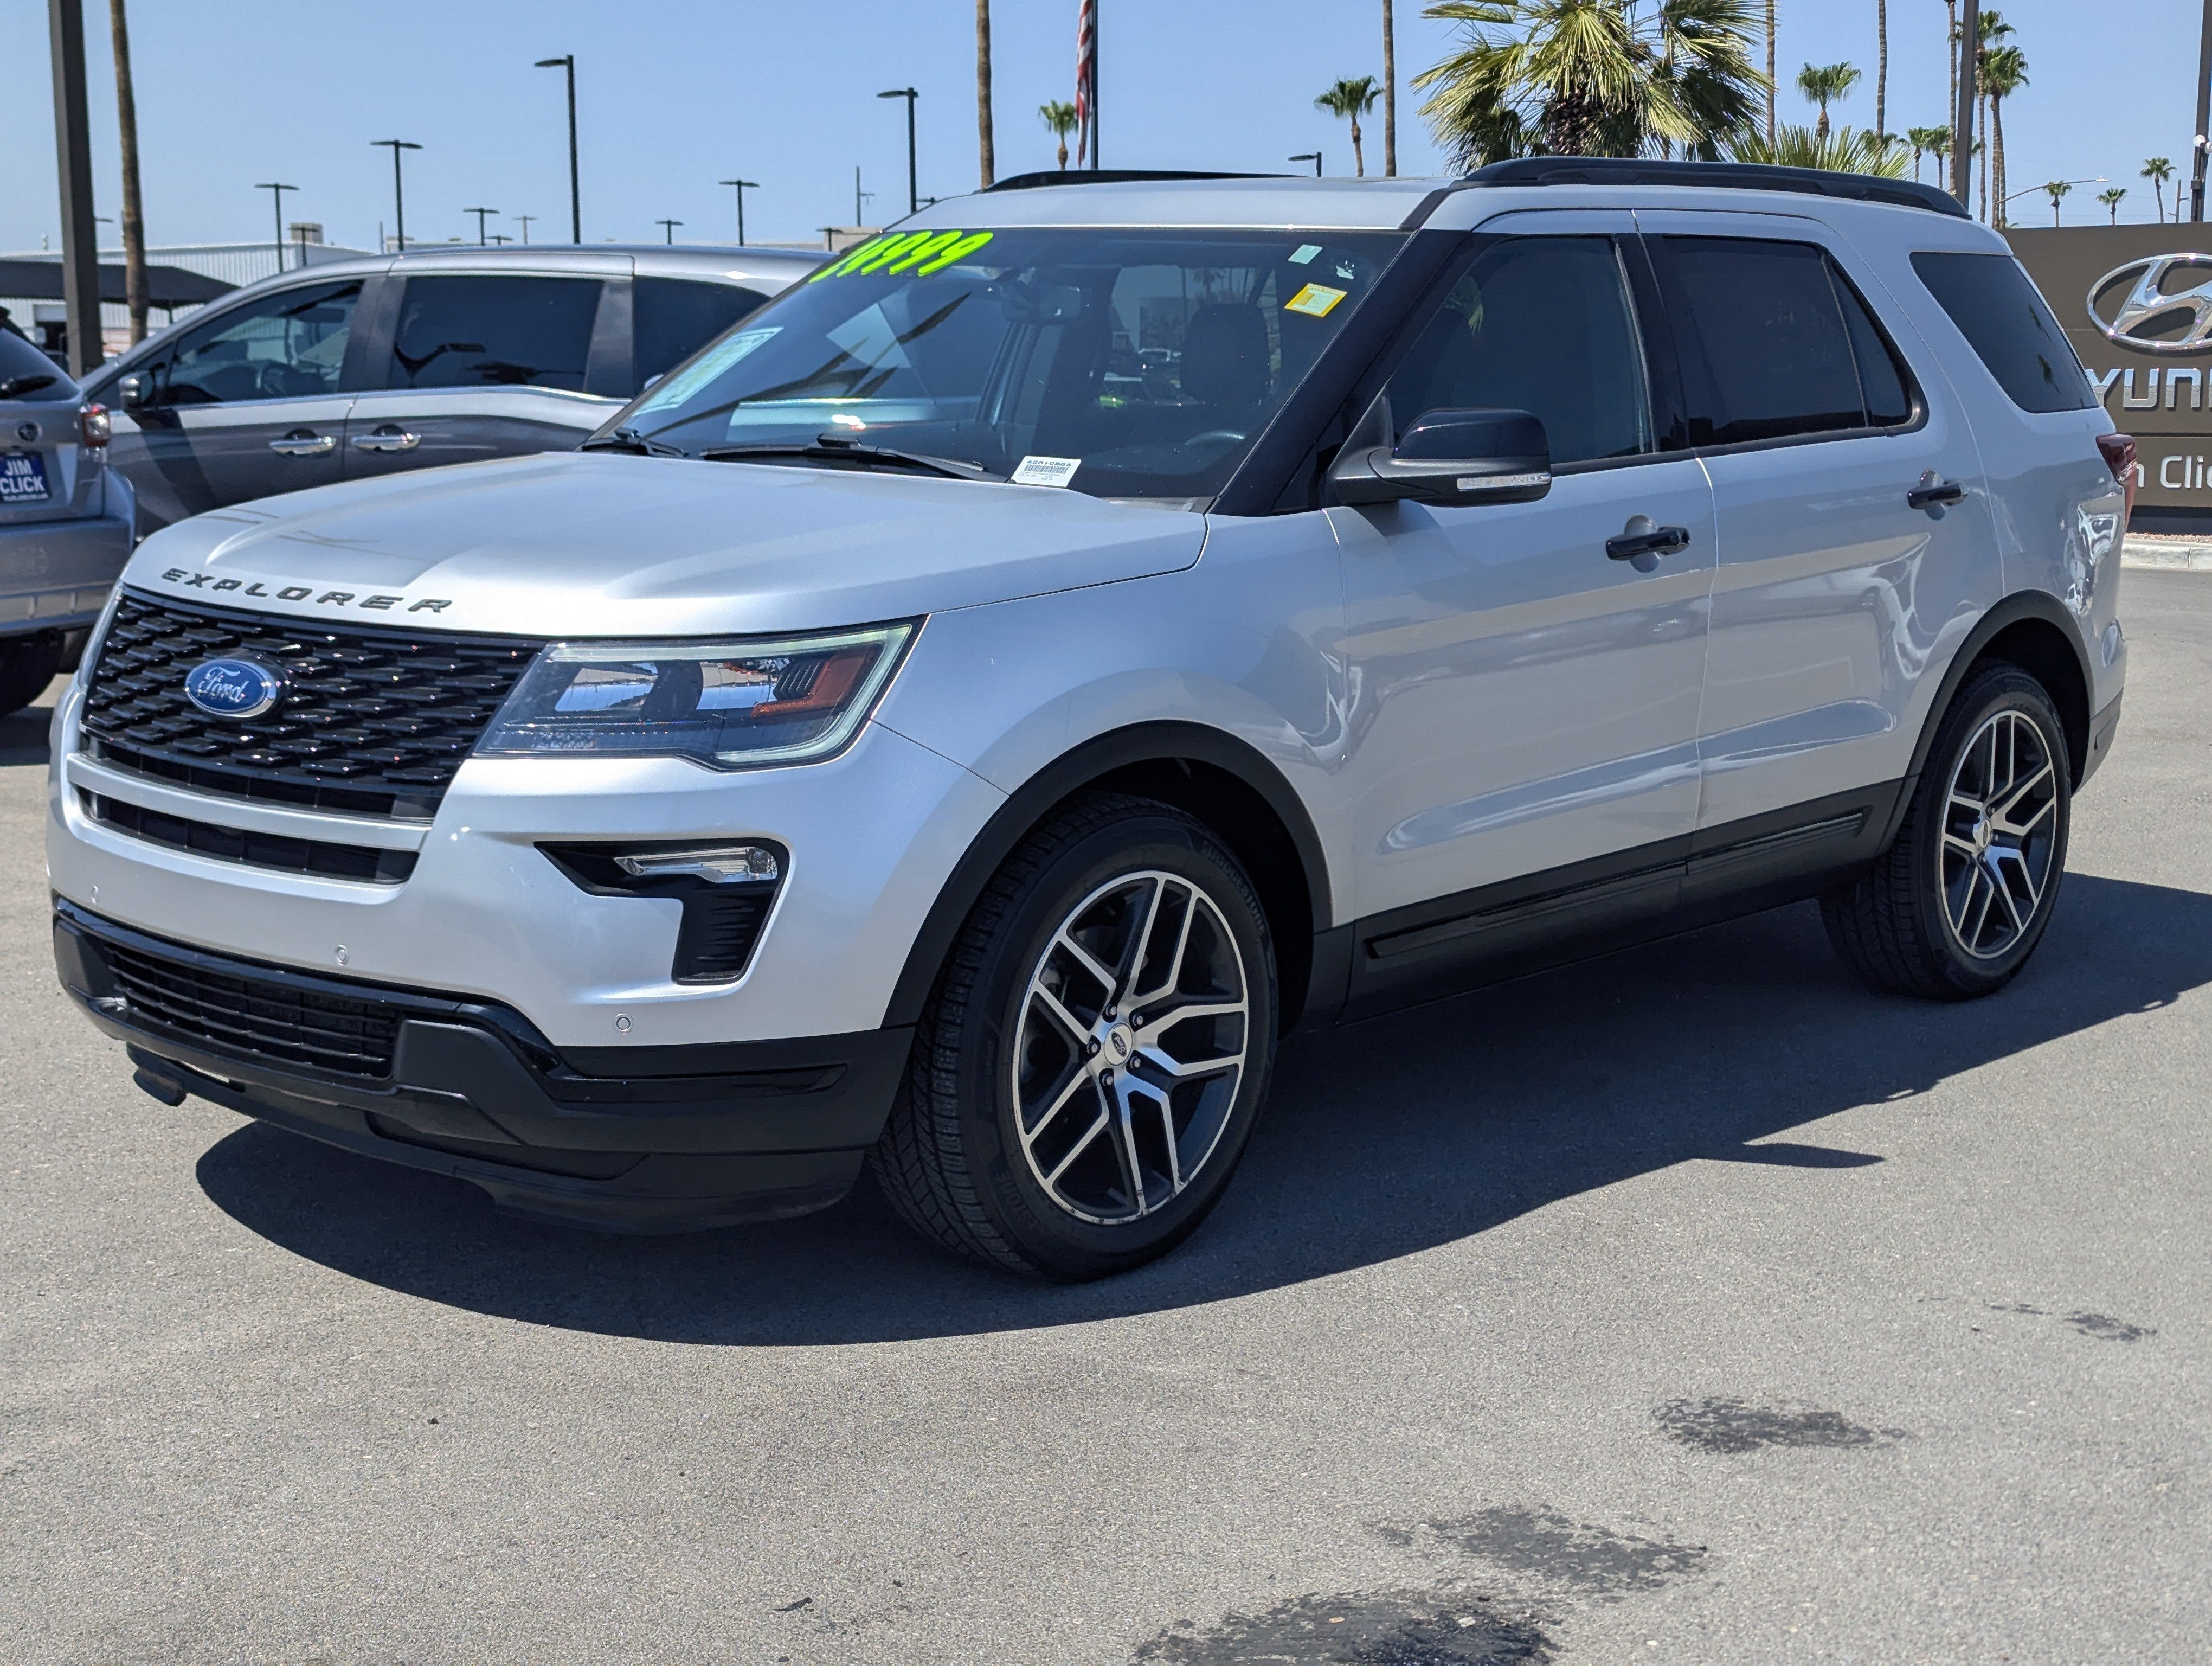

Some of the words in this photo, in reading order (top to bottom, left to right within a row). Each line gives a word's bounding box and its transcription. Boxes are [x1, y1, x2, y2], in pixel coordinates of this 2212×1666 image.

[5, 459, 33, 476] JIM
[0, 476, 46, 494] CLICK
[162, 568, 452, 613] EXPLORER
[197, 667, 249, 703] Ford
